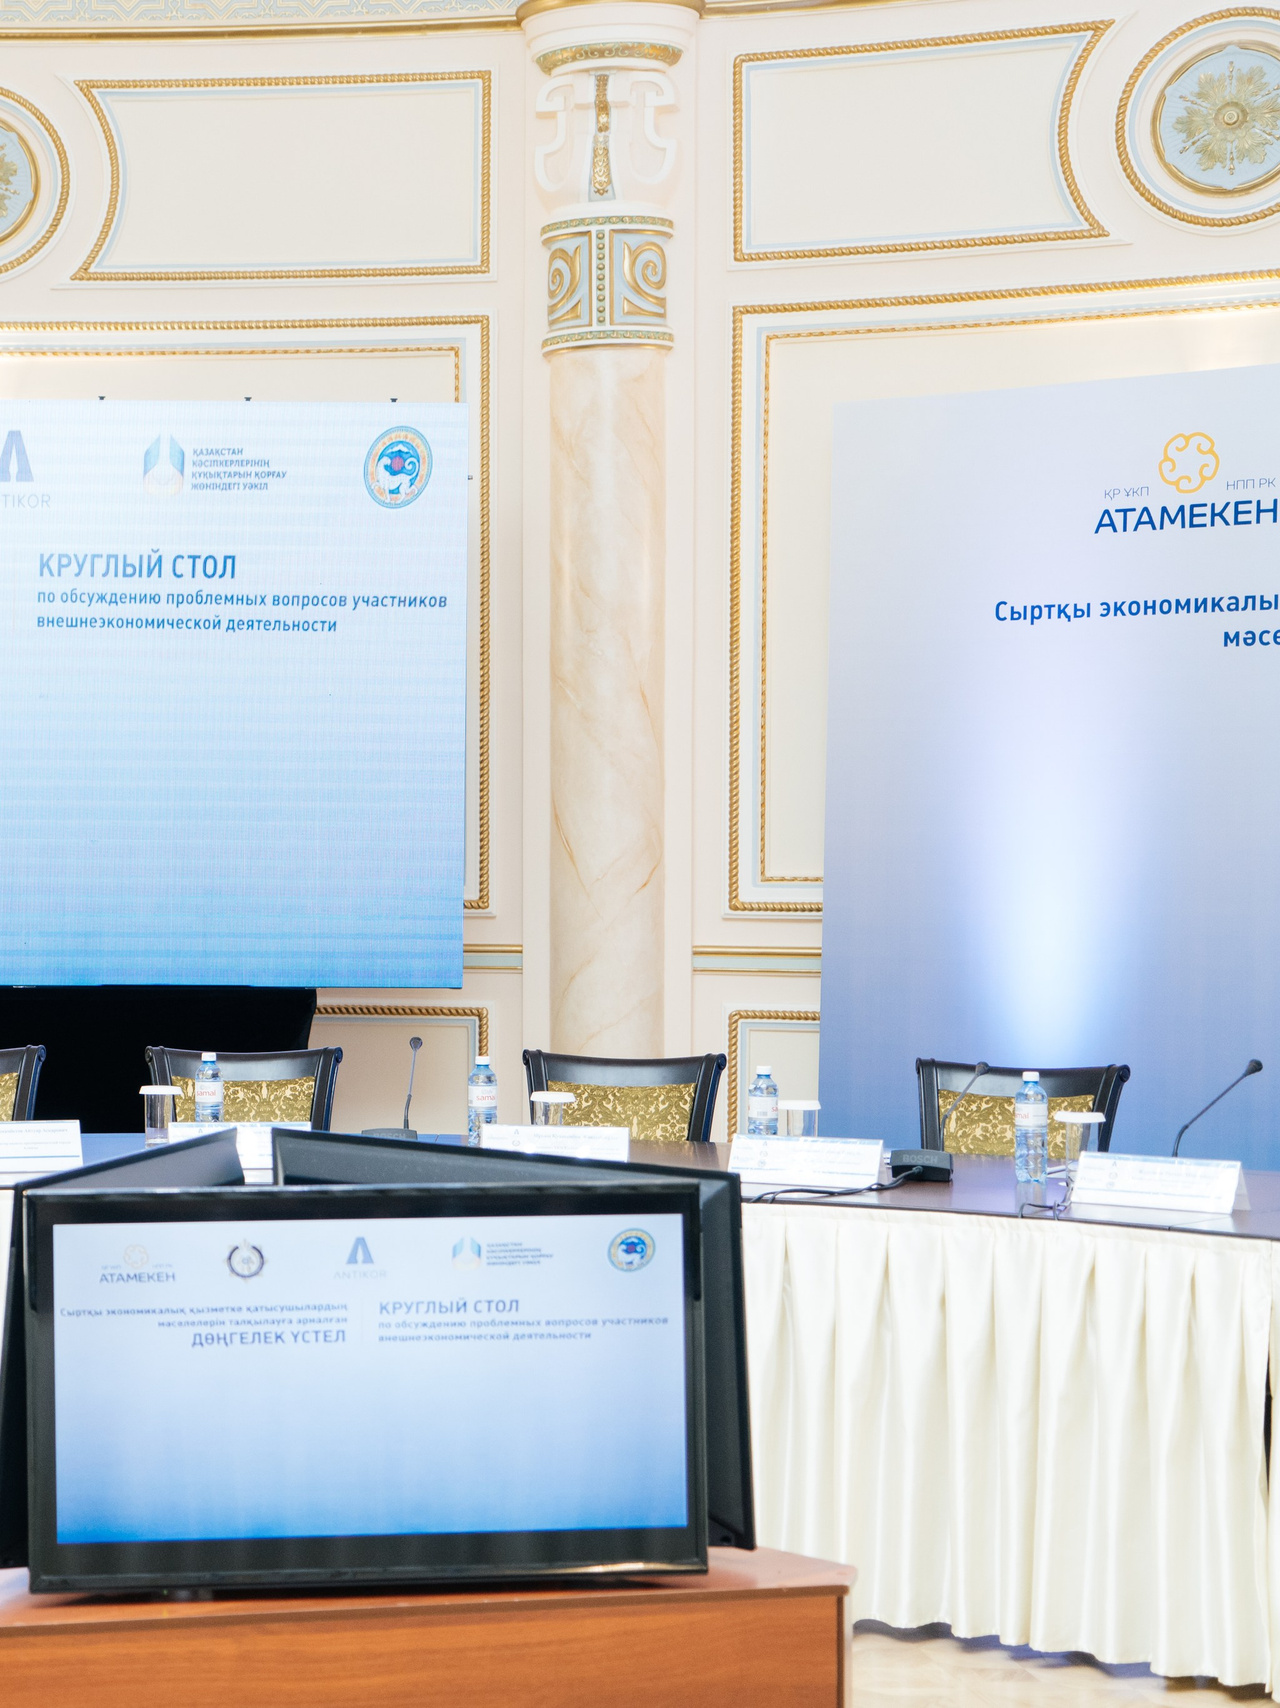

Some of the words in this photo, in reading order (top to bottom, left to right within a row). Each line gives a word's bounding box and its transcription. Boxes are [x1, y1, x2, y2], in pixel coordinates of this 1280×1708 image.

[193, 448, 243, 456] ҚАЗАҚСТАН
[1226, 479, 1255, 490] НПП
[1259, 478, 1276, 488] РК
[1104, 488, 1120, 500] ҚР
[1124, 486, 1149, 497] ҰКП
[1094, 498, 1278, 534] АТАМЕКЕН
[39, 548, 162, 578] КРУГЛЫЙ
[172, 555, 236, 579] СТОЛ
[38, 591, 55, 603] по
[61, 588, 161, 607] обсуждению
[166, 590, 266, 608] проблемных
[272, 595, 347, 610] вопросов
[353, 595, 447, 611] участников
[994, 601, 1091, 626] Сыртқы
[37, 615, 221, 630] внешнеэкономической
[226, 619, 337, 633] деятельности
[903, 1154, 938, 1163] BOSCH
[99, 1272, 176, 1283] АТАМЕКЕН
[379, 1297, 467, 1315] КРУГЛЫЙ
[474, 1300, 519, 1313] СТОЛ
[192, 1332, 285, 1347] ДӨҢГЕЛЕК
[291, 1330, 345, 1343] ҮСТЕЛ
